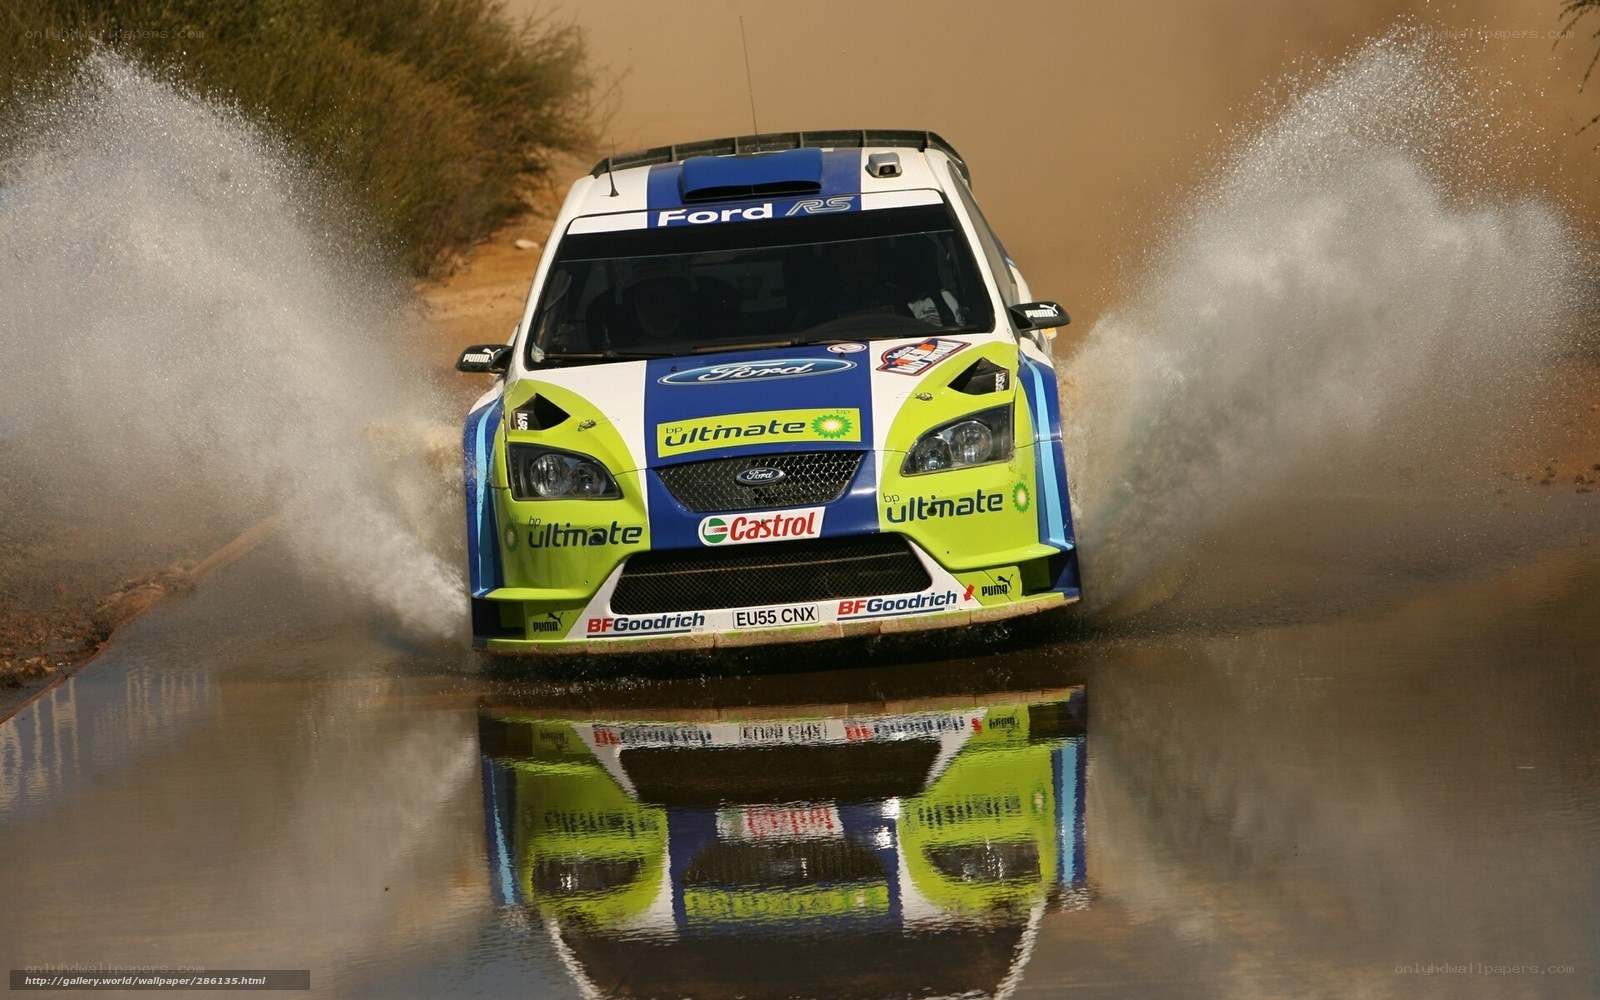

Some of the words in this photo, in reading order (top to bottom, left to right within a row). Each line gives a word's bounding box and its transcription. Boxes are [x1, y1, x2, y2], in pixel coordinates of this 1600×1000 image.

[657, 203, 773, 227] Ford
[785, 196, 855, 217] RS
[697, 361, 817, 382] Ford
[665, 426, 683, 436] bp
[665, 419, 806, 447] ultimate
[746, 469, 774, 480] Ford
[883, 492, 900, 505] bp
[886, 489, 1003, 523] ultimate
[528, 515, 541, 528] bp
[730, 511, 816, 541] Castrol
[528, 520, 643, 549] ultimate
[981, 584, 1009, 597] PUMA
[838, 590, 957, 615] BFGoodrich
[533, 621, 560, 633] PUMA
[587, 612, 705, 634] BFGoodrich
[736, 609, 777, 627] EU55
[781, 606, 816, 624] CNX
